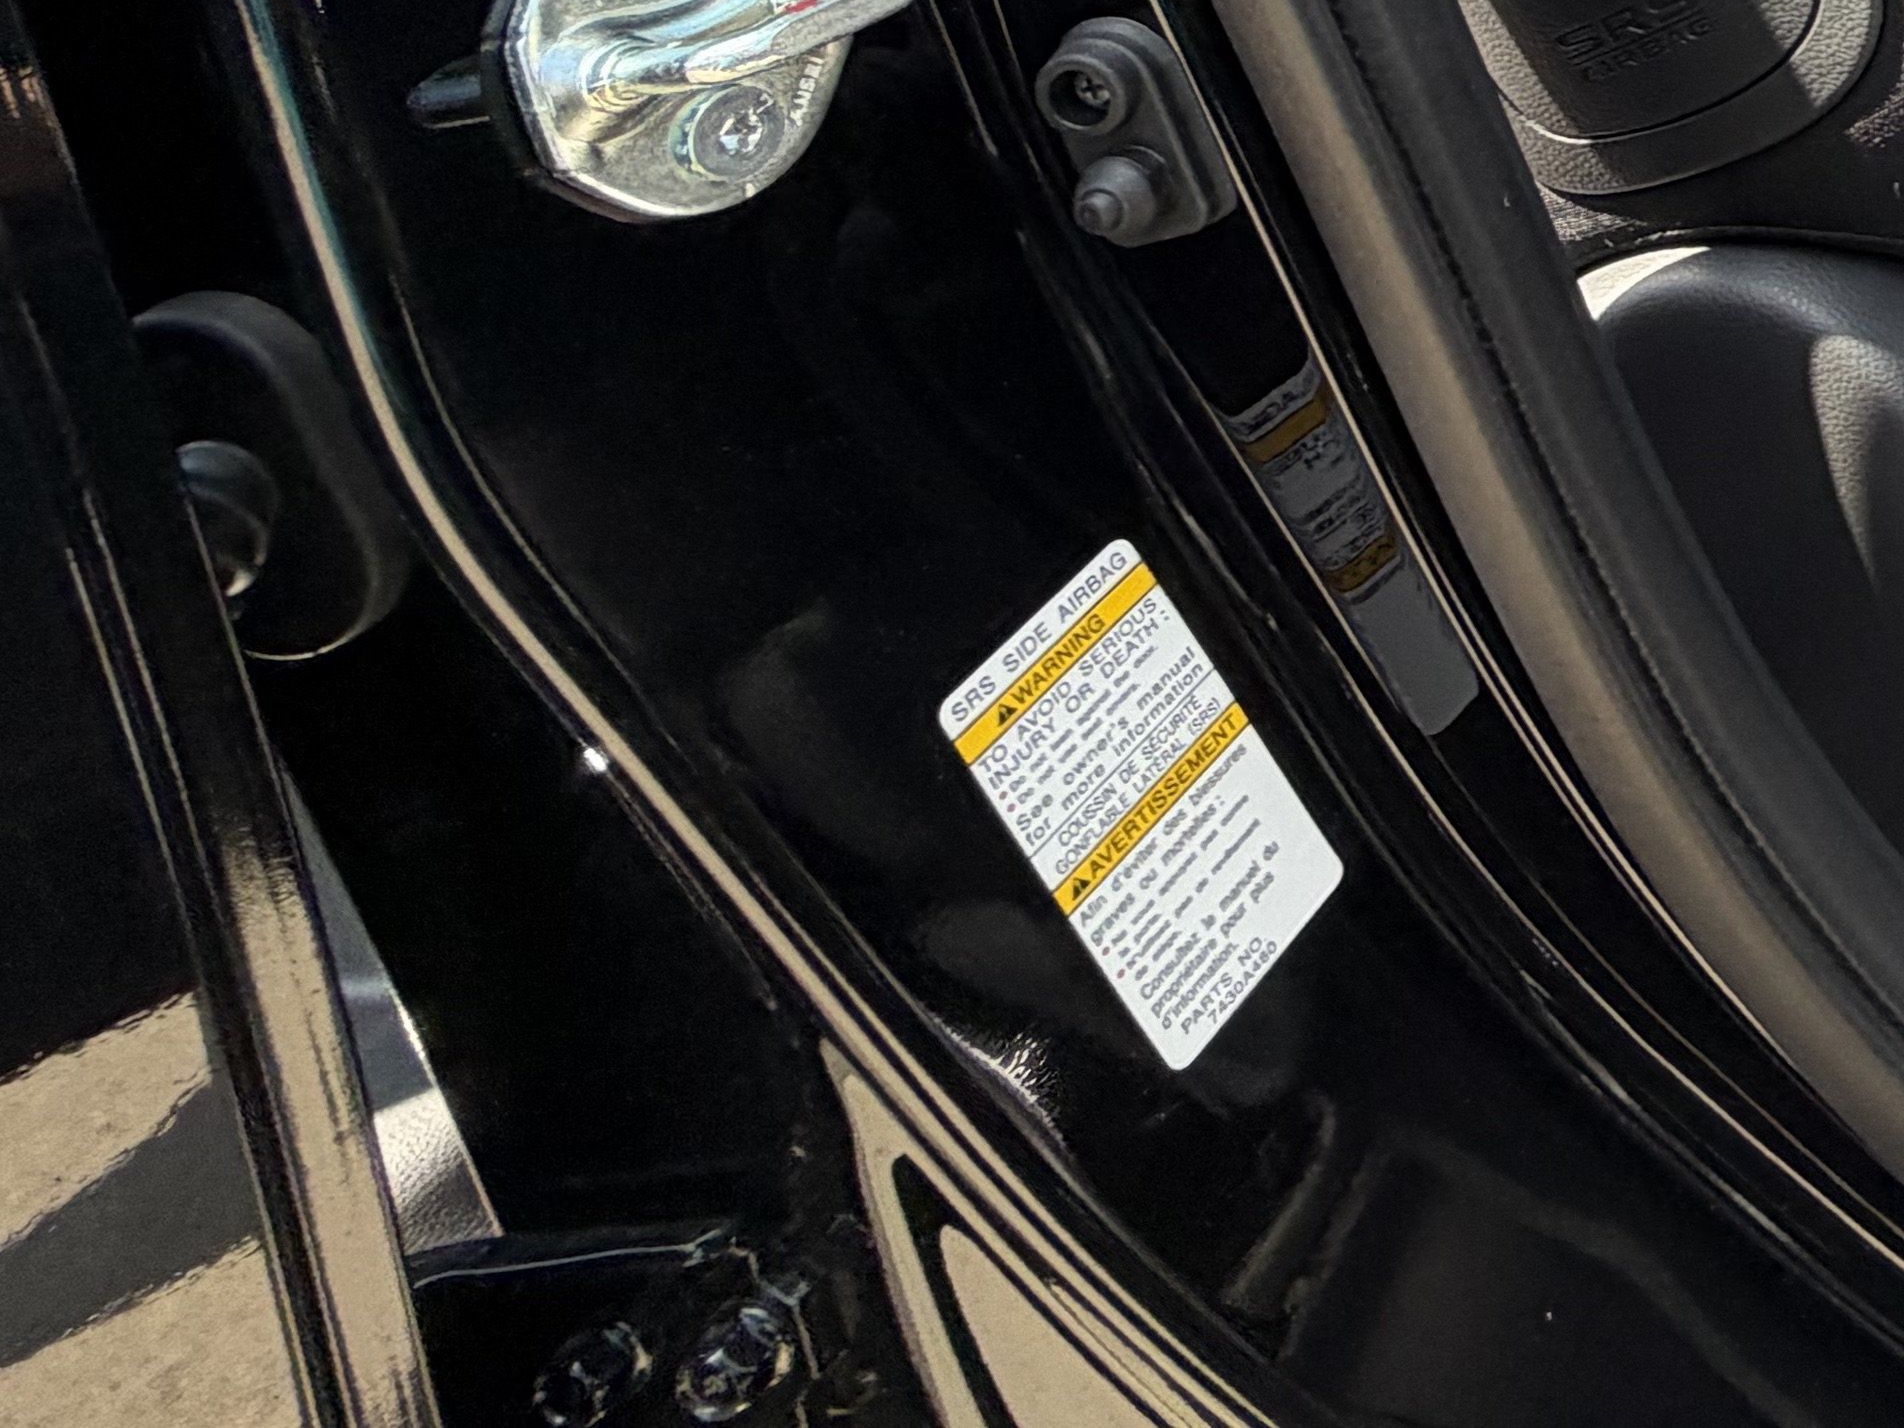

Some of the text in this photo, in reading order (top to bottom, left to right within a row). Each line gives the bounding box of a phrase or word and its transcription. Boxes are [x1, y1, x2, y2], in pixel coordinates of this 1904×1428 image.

[950, 551, 1128, 722] SRS SIDE AIRBAG
[973, 596, 1157, 773] TO AVOID SERIOUS
[1009, 612, 1106, 705] WARNING
[987, 713, 1056, 790] INJURY
[1063, 681, 1096, 714] OR
[1015, 645, 1196, 832] See owner's manual
[1024, 662, 1204, 847] for more information
[1053, 791, 1132, 875] GONFLABLE
[1186, 696, 1221, 736] (SRS)
[1053, 778, 1118, 847] COUSSIN
[1114, 757, 1140, 784] DE
[1088, 711, 1236, 880] AVERTISSEMENT
[1179, 971, 1233, 1035] PARTS
